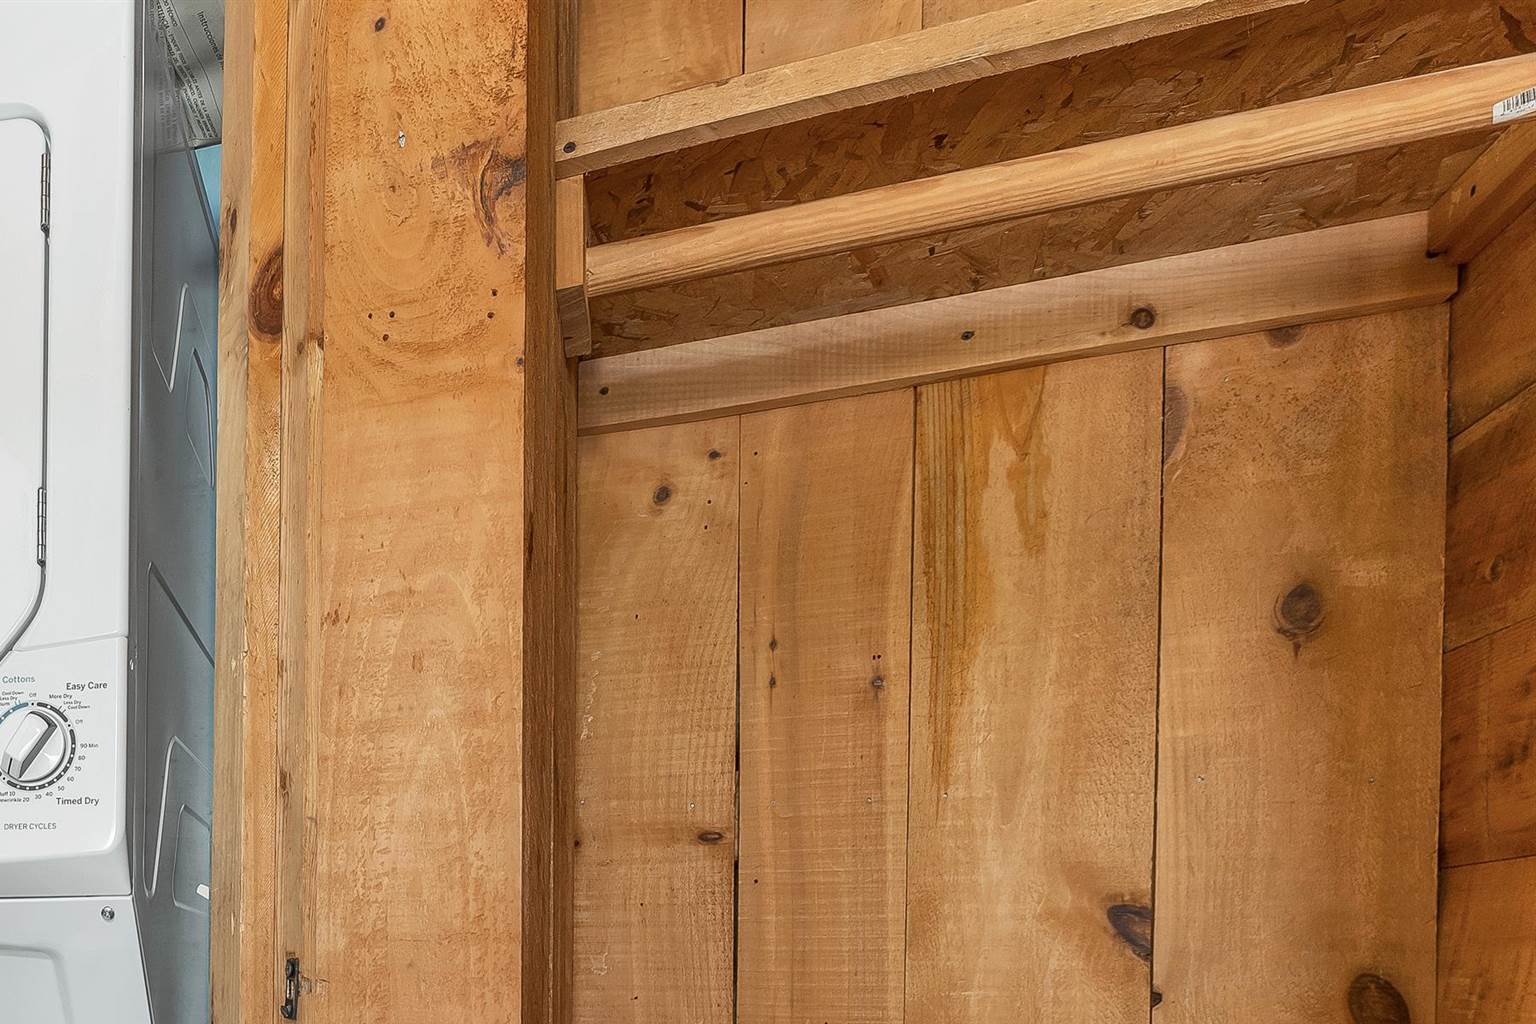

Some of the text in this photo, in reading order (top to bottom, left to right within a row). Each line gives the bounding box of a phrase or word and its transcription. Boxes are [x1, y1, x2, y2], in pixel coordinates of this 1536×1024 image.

[2, 676, 35, 684] Cottons
[66, 681, 108, 691] Easy Care
[56, 797, 100, 806] Timed Dry
